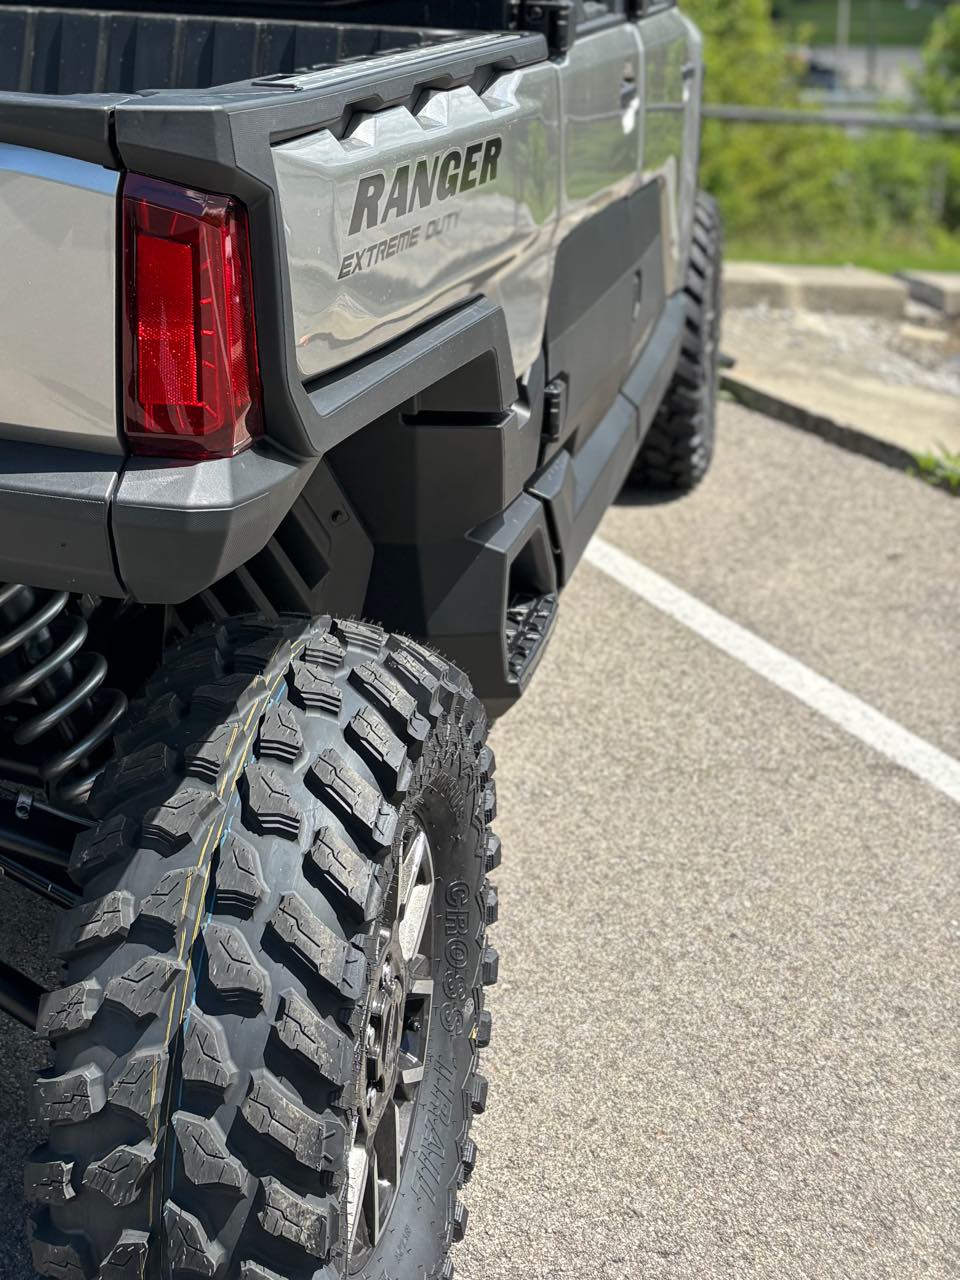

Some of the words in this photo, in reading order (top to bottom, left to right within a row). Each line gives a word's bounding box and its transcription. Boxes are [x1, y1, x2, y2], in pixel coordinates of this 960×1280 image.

[348, 137, 502, 236] RANGER
[337, 226, 421, 280] EXTREME
[440, 880, 471, 1037] CROSS
